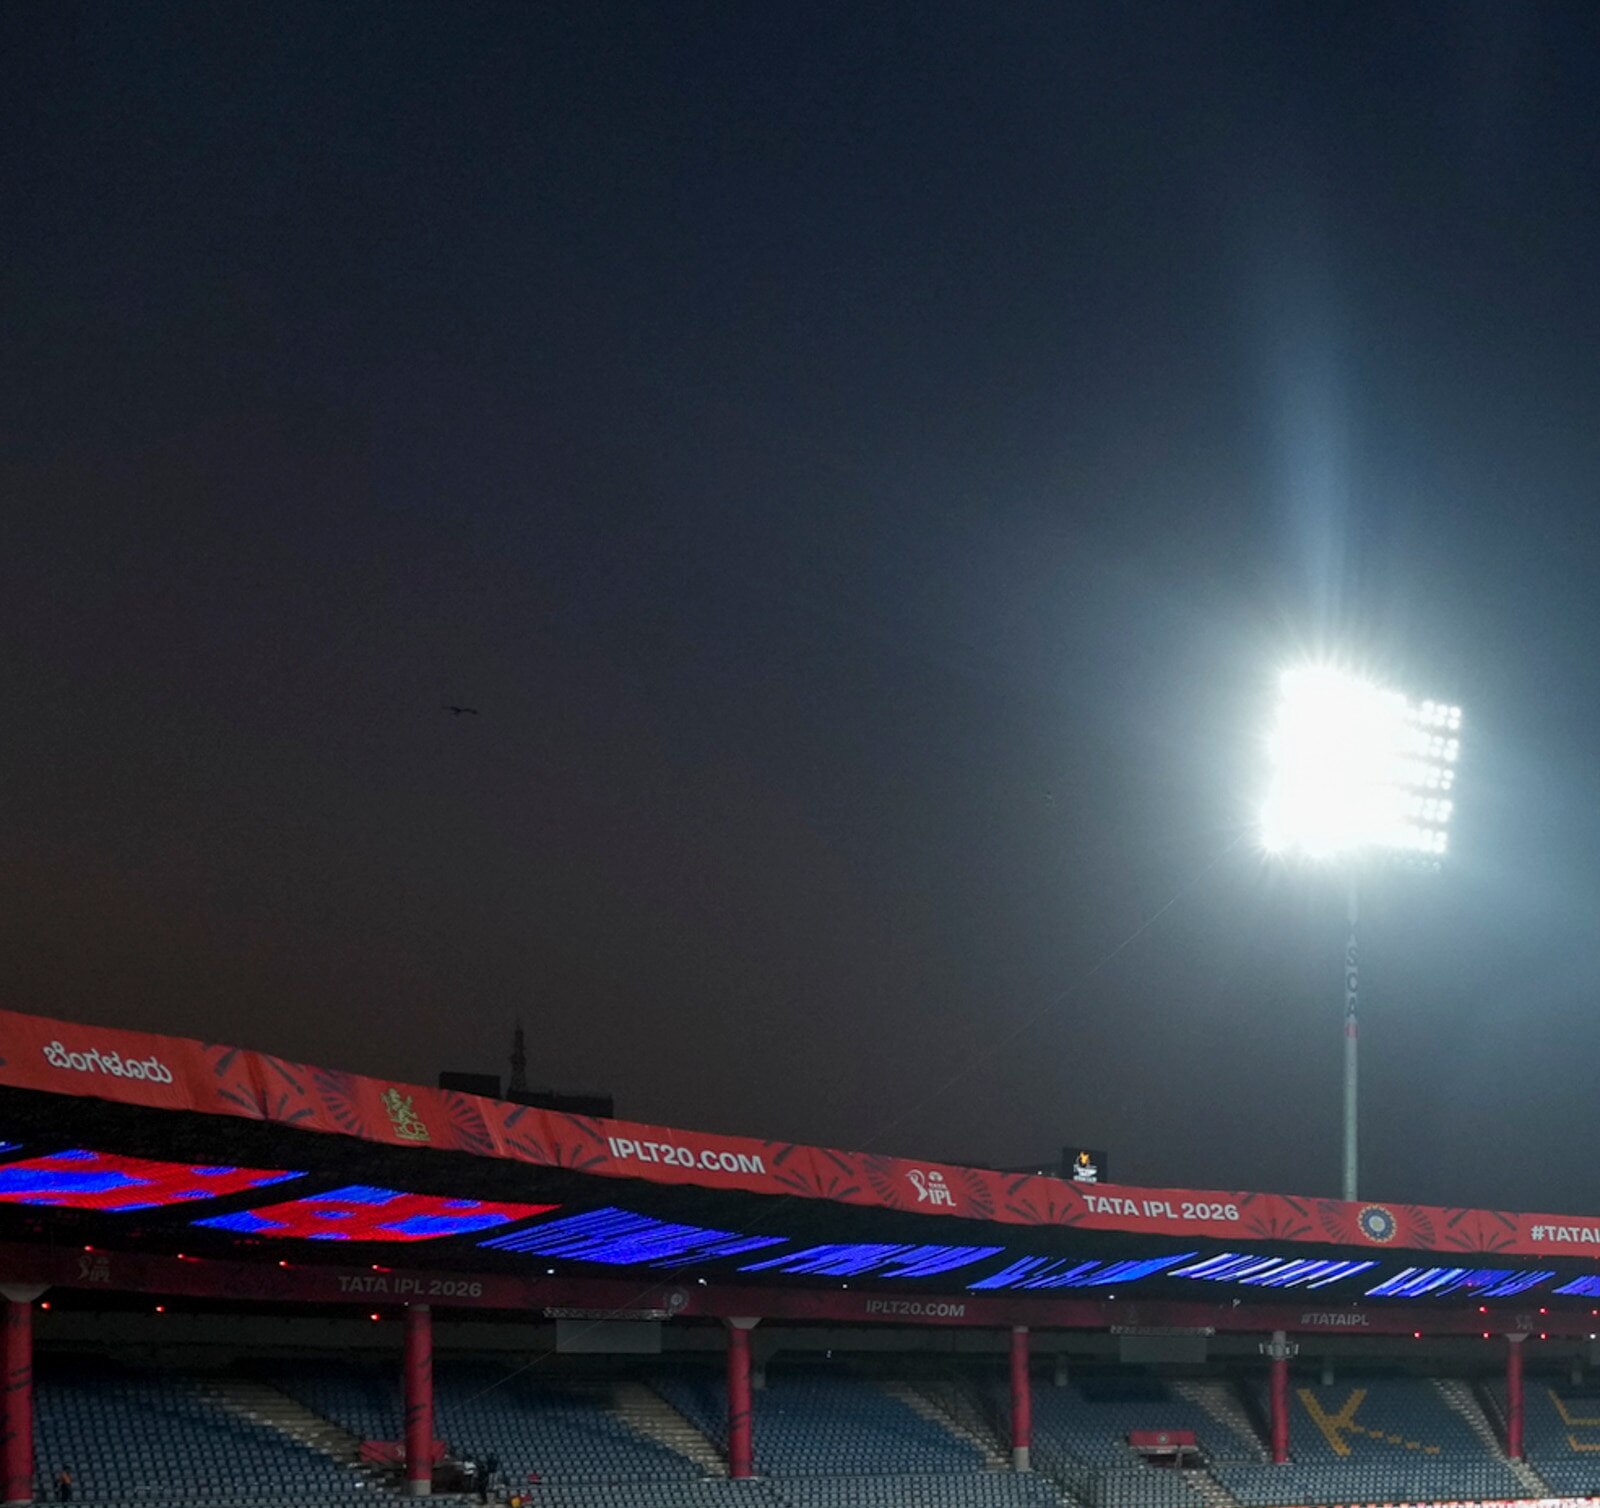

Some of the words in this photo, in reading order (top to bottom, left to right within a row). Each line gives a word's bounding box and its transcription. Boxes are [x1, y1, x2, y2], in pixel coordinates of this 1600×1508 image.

[608, 1136, 766, 1175] IPLT20.COM
[928, 1189, 956, 1207] IPL
[1082, 1195, 1139, 1217] TATA
[1143, 1200, 1178, 1219] IPL
[1180, 1202, 1240, 1221] 2026
[337, 1276, 387, 1294] TATA
[394, 1279, 424, 1295] IPL
[429, 1279, 483, 1298] 2026
[865, 1299, 965, 1318] IPLT20.COM
[1301, 1311, 1370, 1327] #TATAIPL
